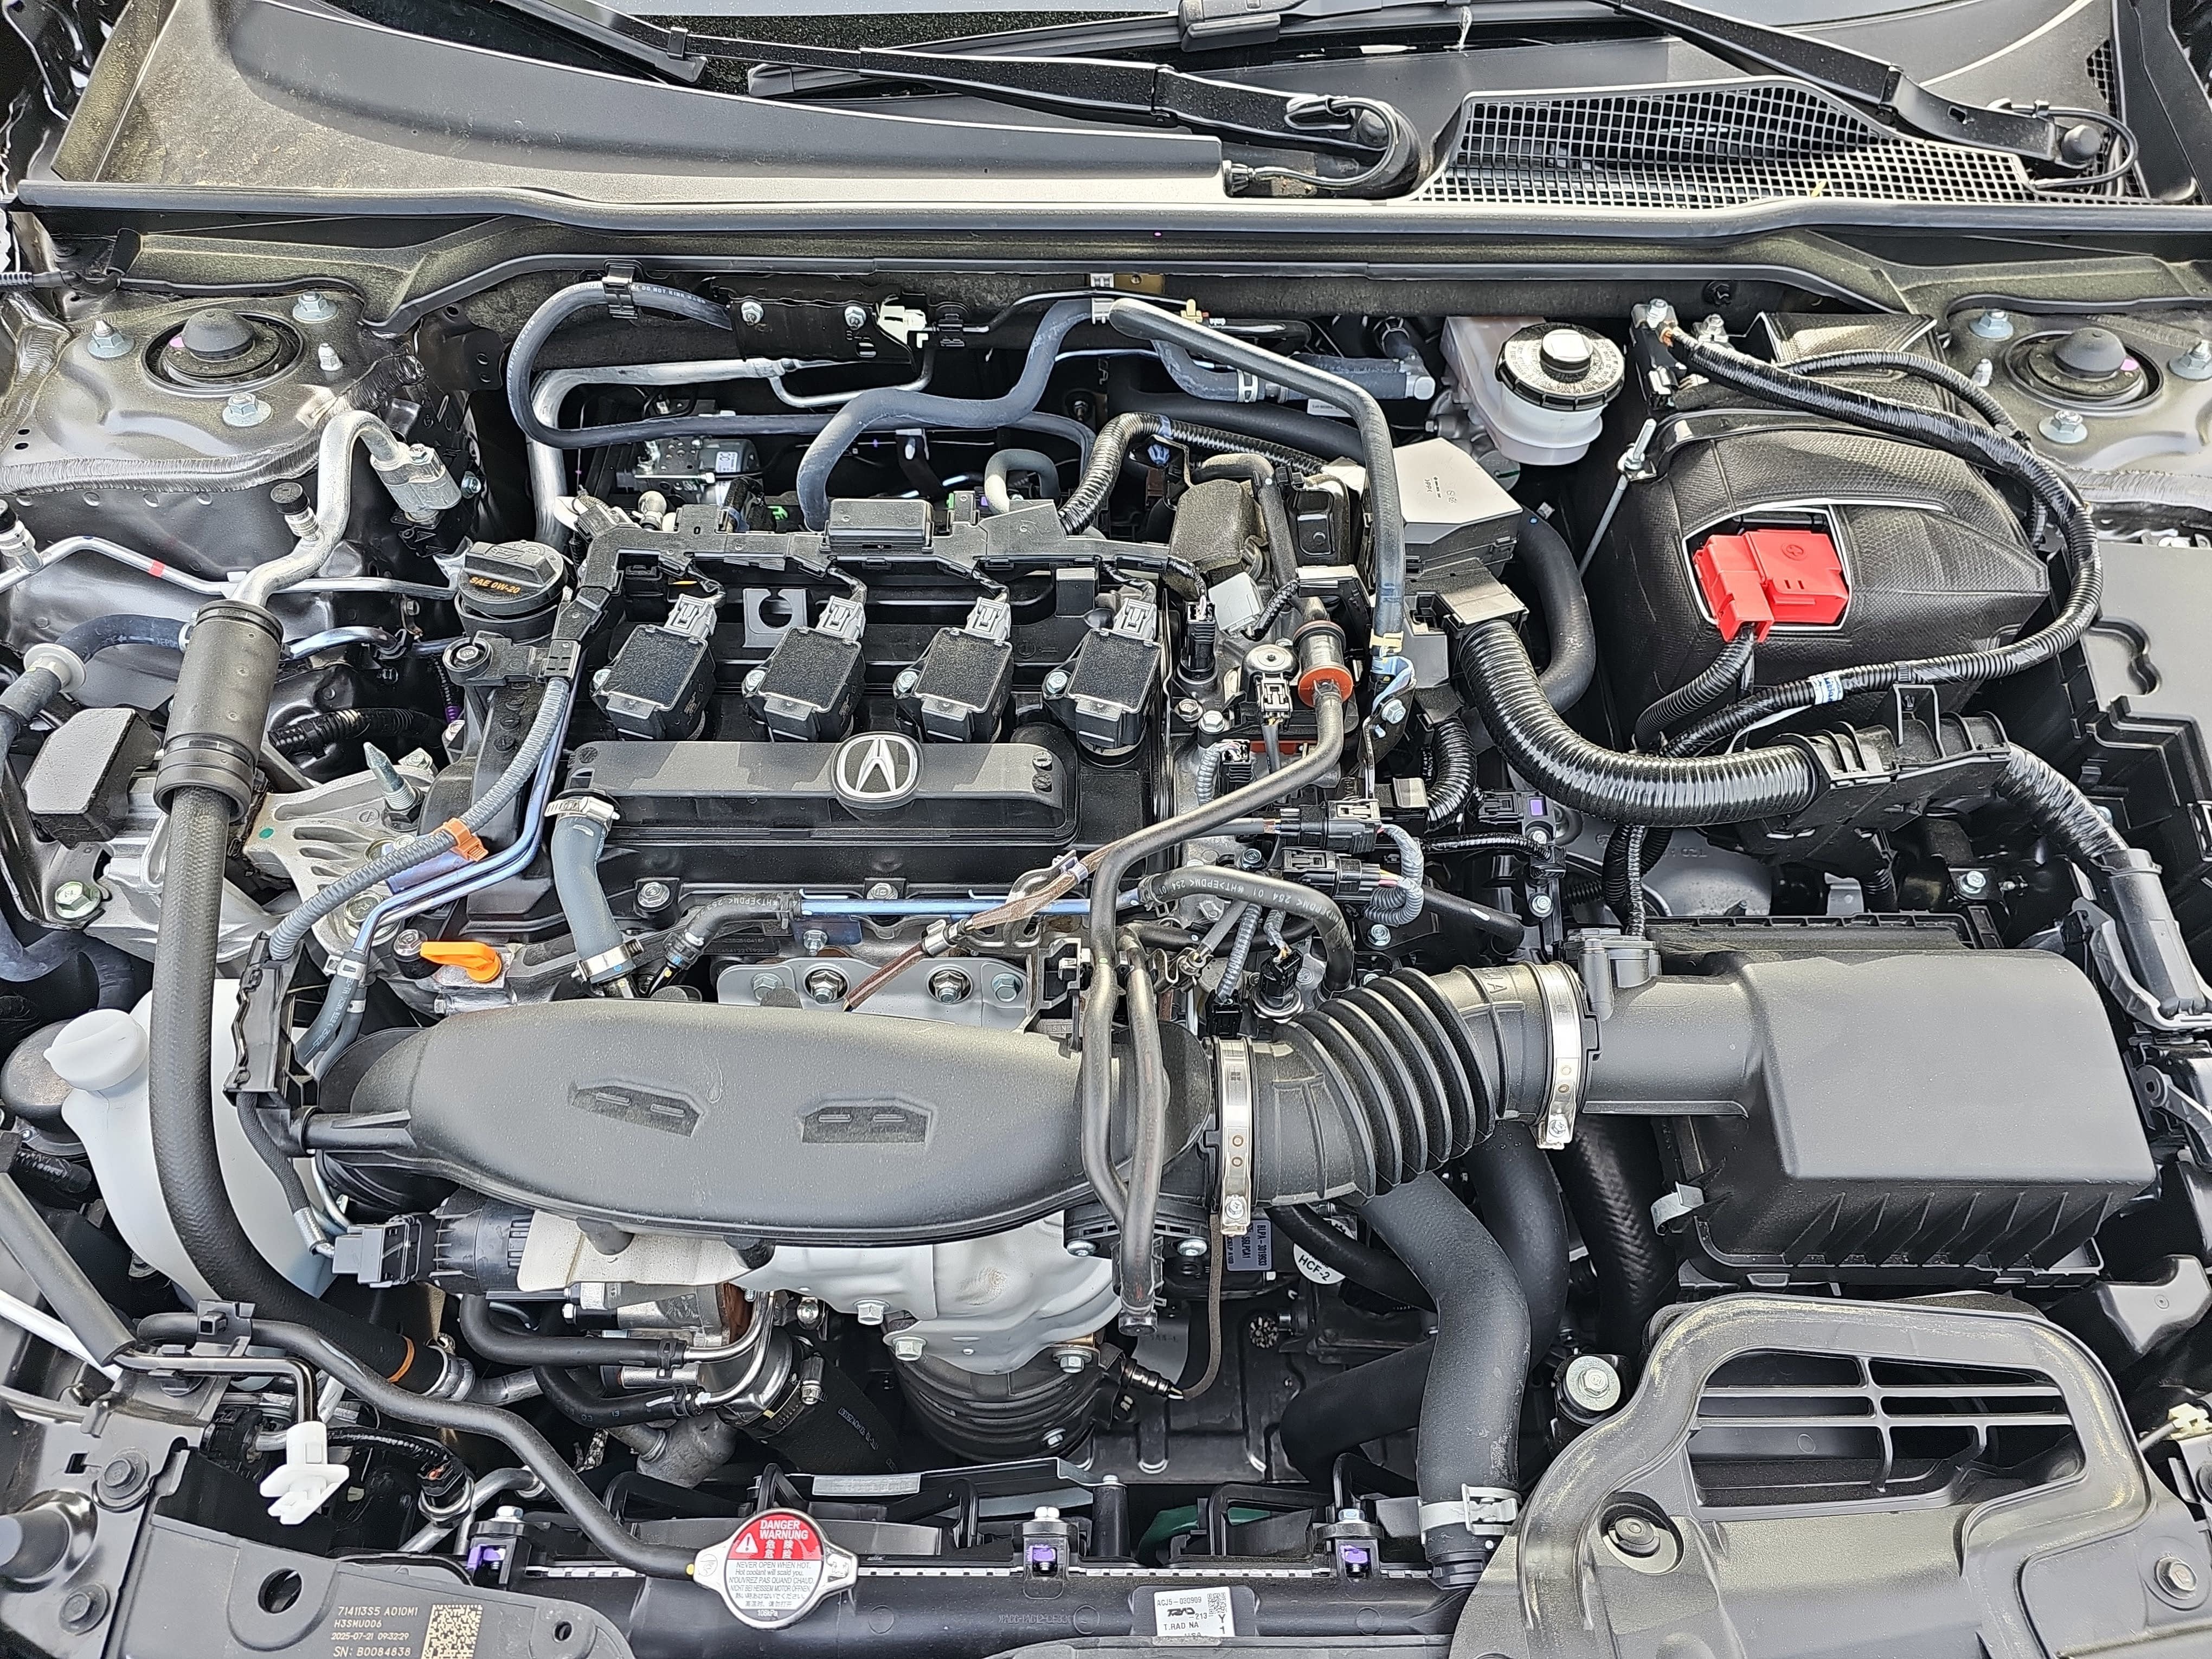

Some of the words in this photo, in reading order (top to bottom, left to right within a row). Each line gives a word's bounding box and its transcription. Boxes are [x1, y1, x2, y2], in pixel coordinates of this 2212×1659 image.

[470, 577, 491, 587] SAE
[491, 582, 520, 594] 0W-20
[1171, 879, 1186, 891] 254
[1252, 888, 1265, 898] 01
[1273, 892, 1292, 904] 254
[1298, 1254, 1330, 1282] HCF-2
[760, 1520, 801, 1529] DANGER
[760, 1529, 809, 1540] WARNUNG
[338, 1606, 381, 1616] 714113S5
[334, 1619, 382, 1628] H3SMU006
[1218, 1613, 1226, 1624] Y
[1163, 1622, 1186, 1631] T.RAD
[1219, 1625, 1225, 1635] 1
[331, 1631, 374, 1641] 2025-07-21
[333, 1645, 353, 1658] SN:
[356, 1646, 411, 1657] B0084838
